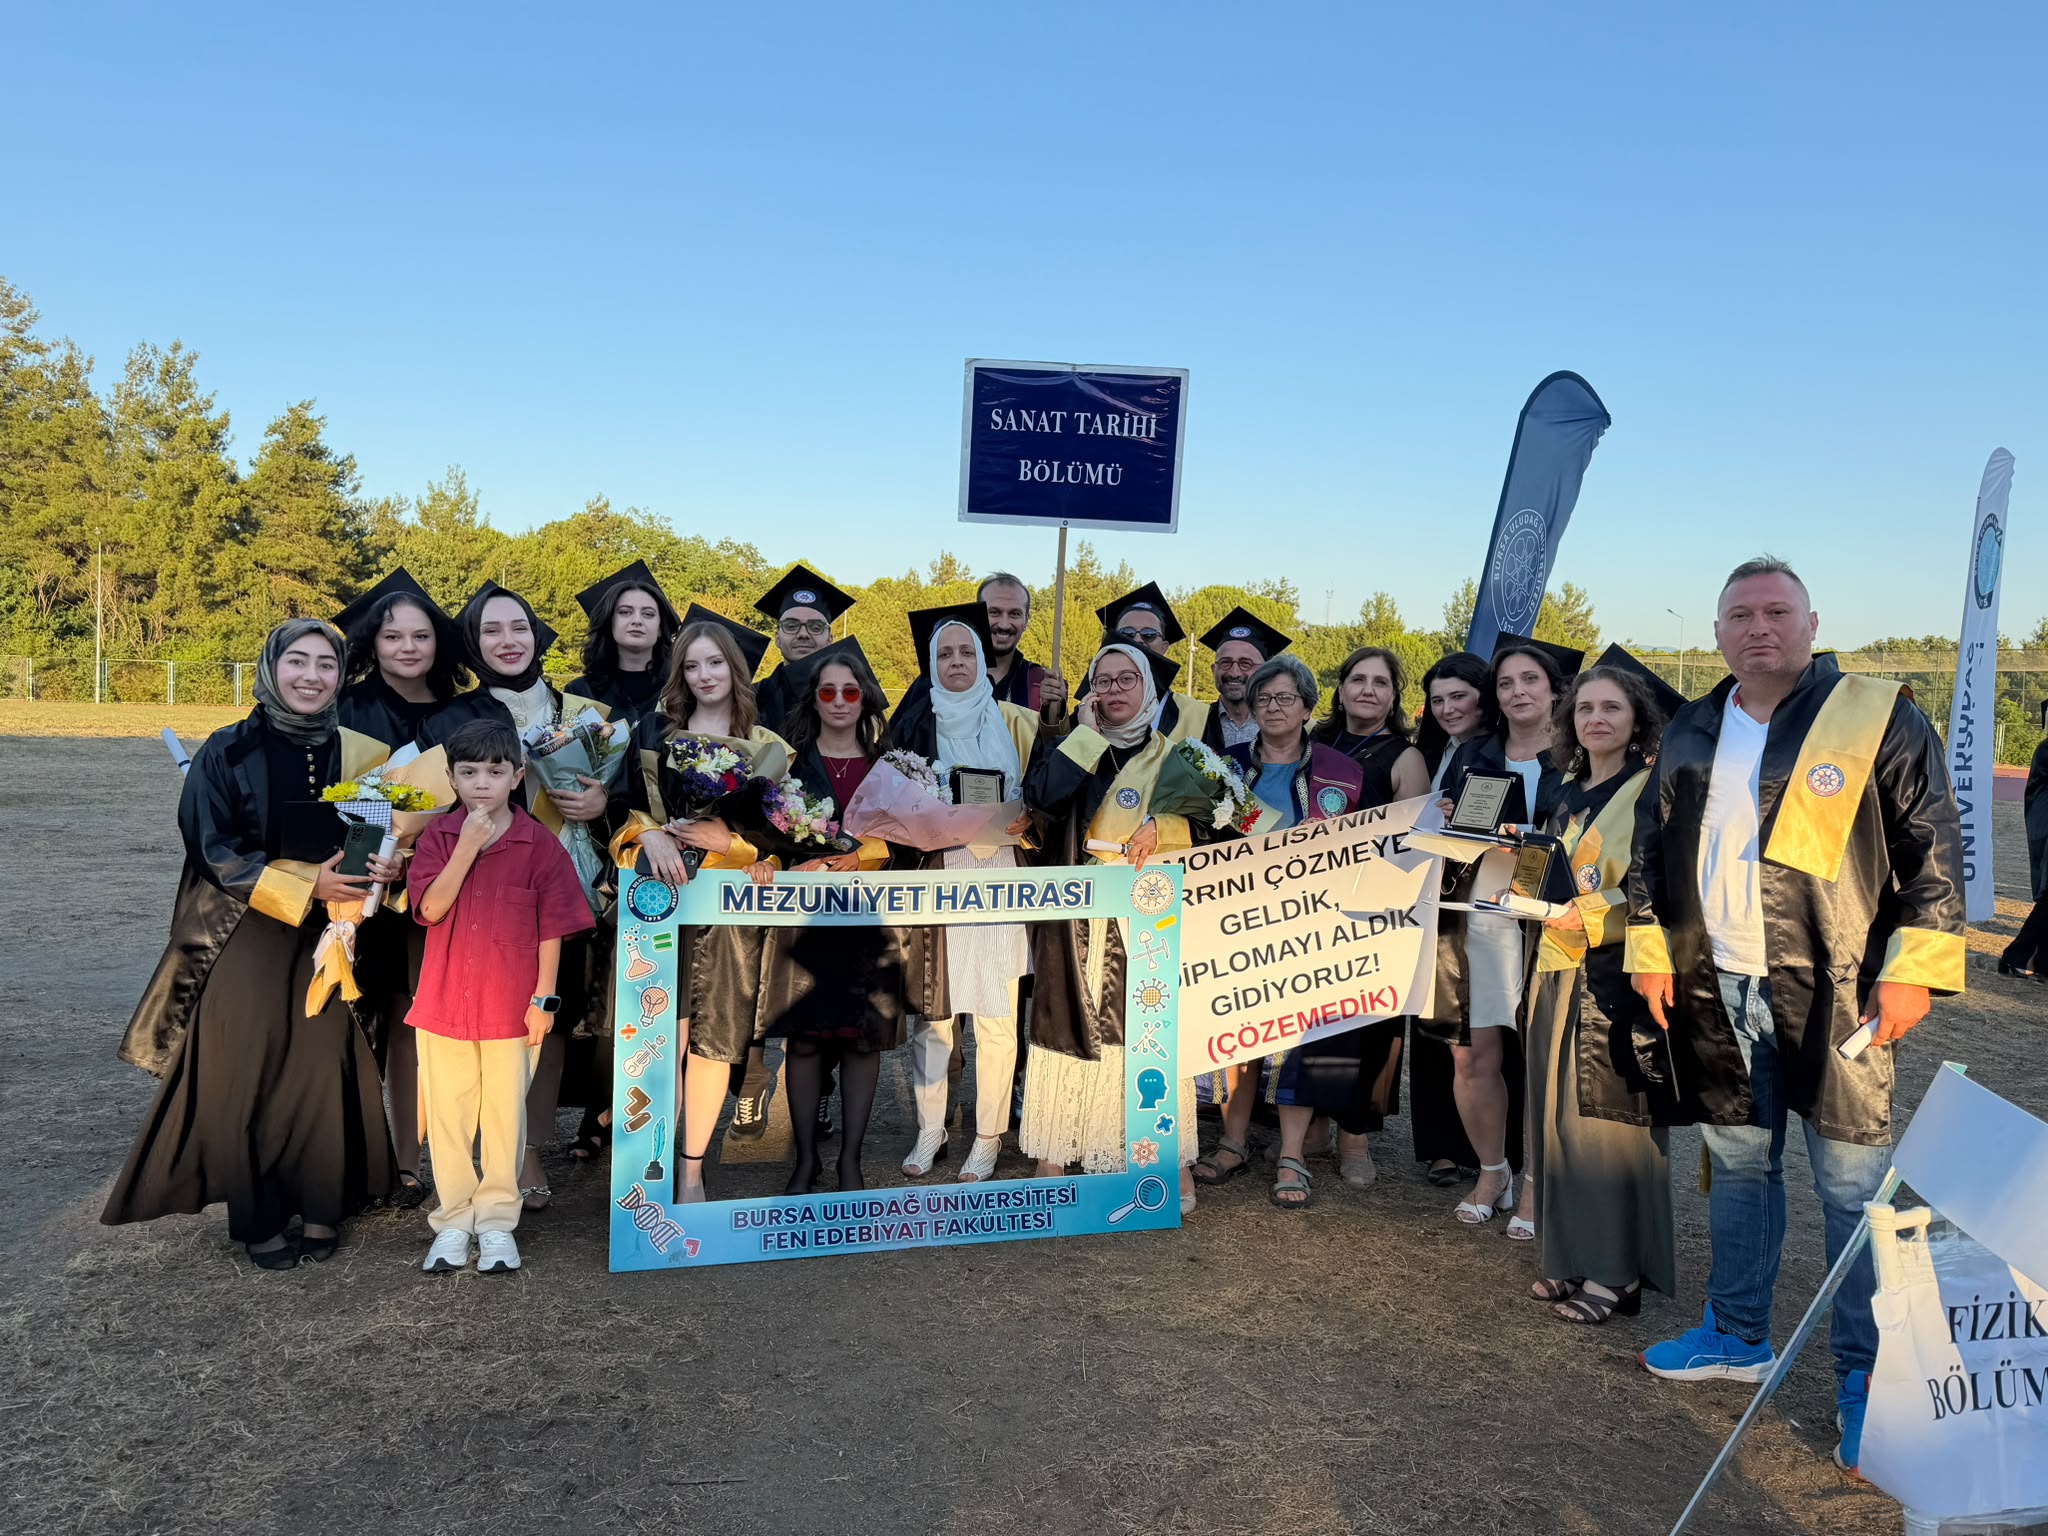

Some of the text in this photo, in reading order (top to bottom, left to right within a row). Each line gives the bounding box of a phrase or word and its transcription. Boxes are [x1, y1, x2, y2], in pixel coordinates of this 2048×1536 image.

[990, 408, 1157, 438] SANAT TARİHİ
[1018, 459, 1123, 486] BÖLÜMÜ
[1509, 513, 1539, 534] ULUDAĞ
[1264, 832, 1412, 890] ÇÖZMEYE
[721, 877, 928, 914] MEZUNİYET
[933, 879, 1094, 913] HATIRASI
[1220, 889, 1341, 936] GELDİK,
[1179, 905, 1421, 989] İPLOMAYI ALDIK
[1211, 952, 1381, 1016] GİDİYORUZ!
[1206, 985, 1399, 1064] (ÇÖZEMEDİK)
[732, 1181, 1077, 1231] BURSA ULUDAĞ ÜNİVERSİTESİ
[762, 1209, 1053, 1252] FEN EDEBİYAT FAKÜLTESİ
[1946, 1290, 2048, 1345] FİZİK
